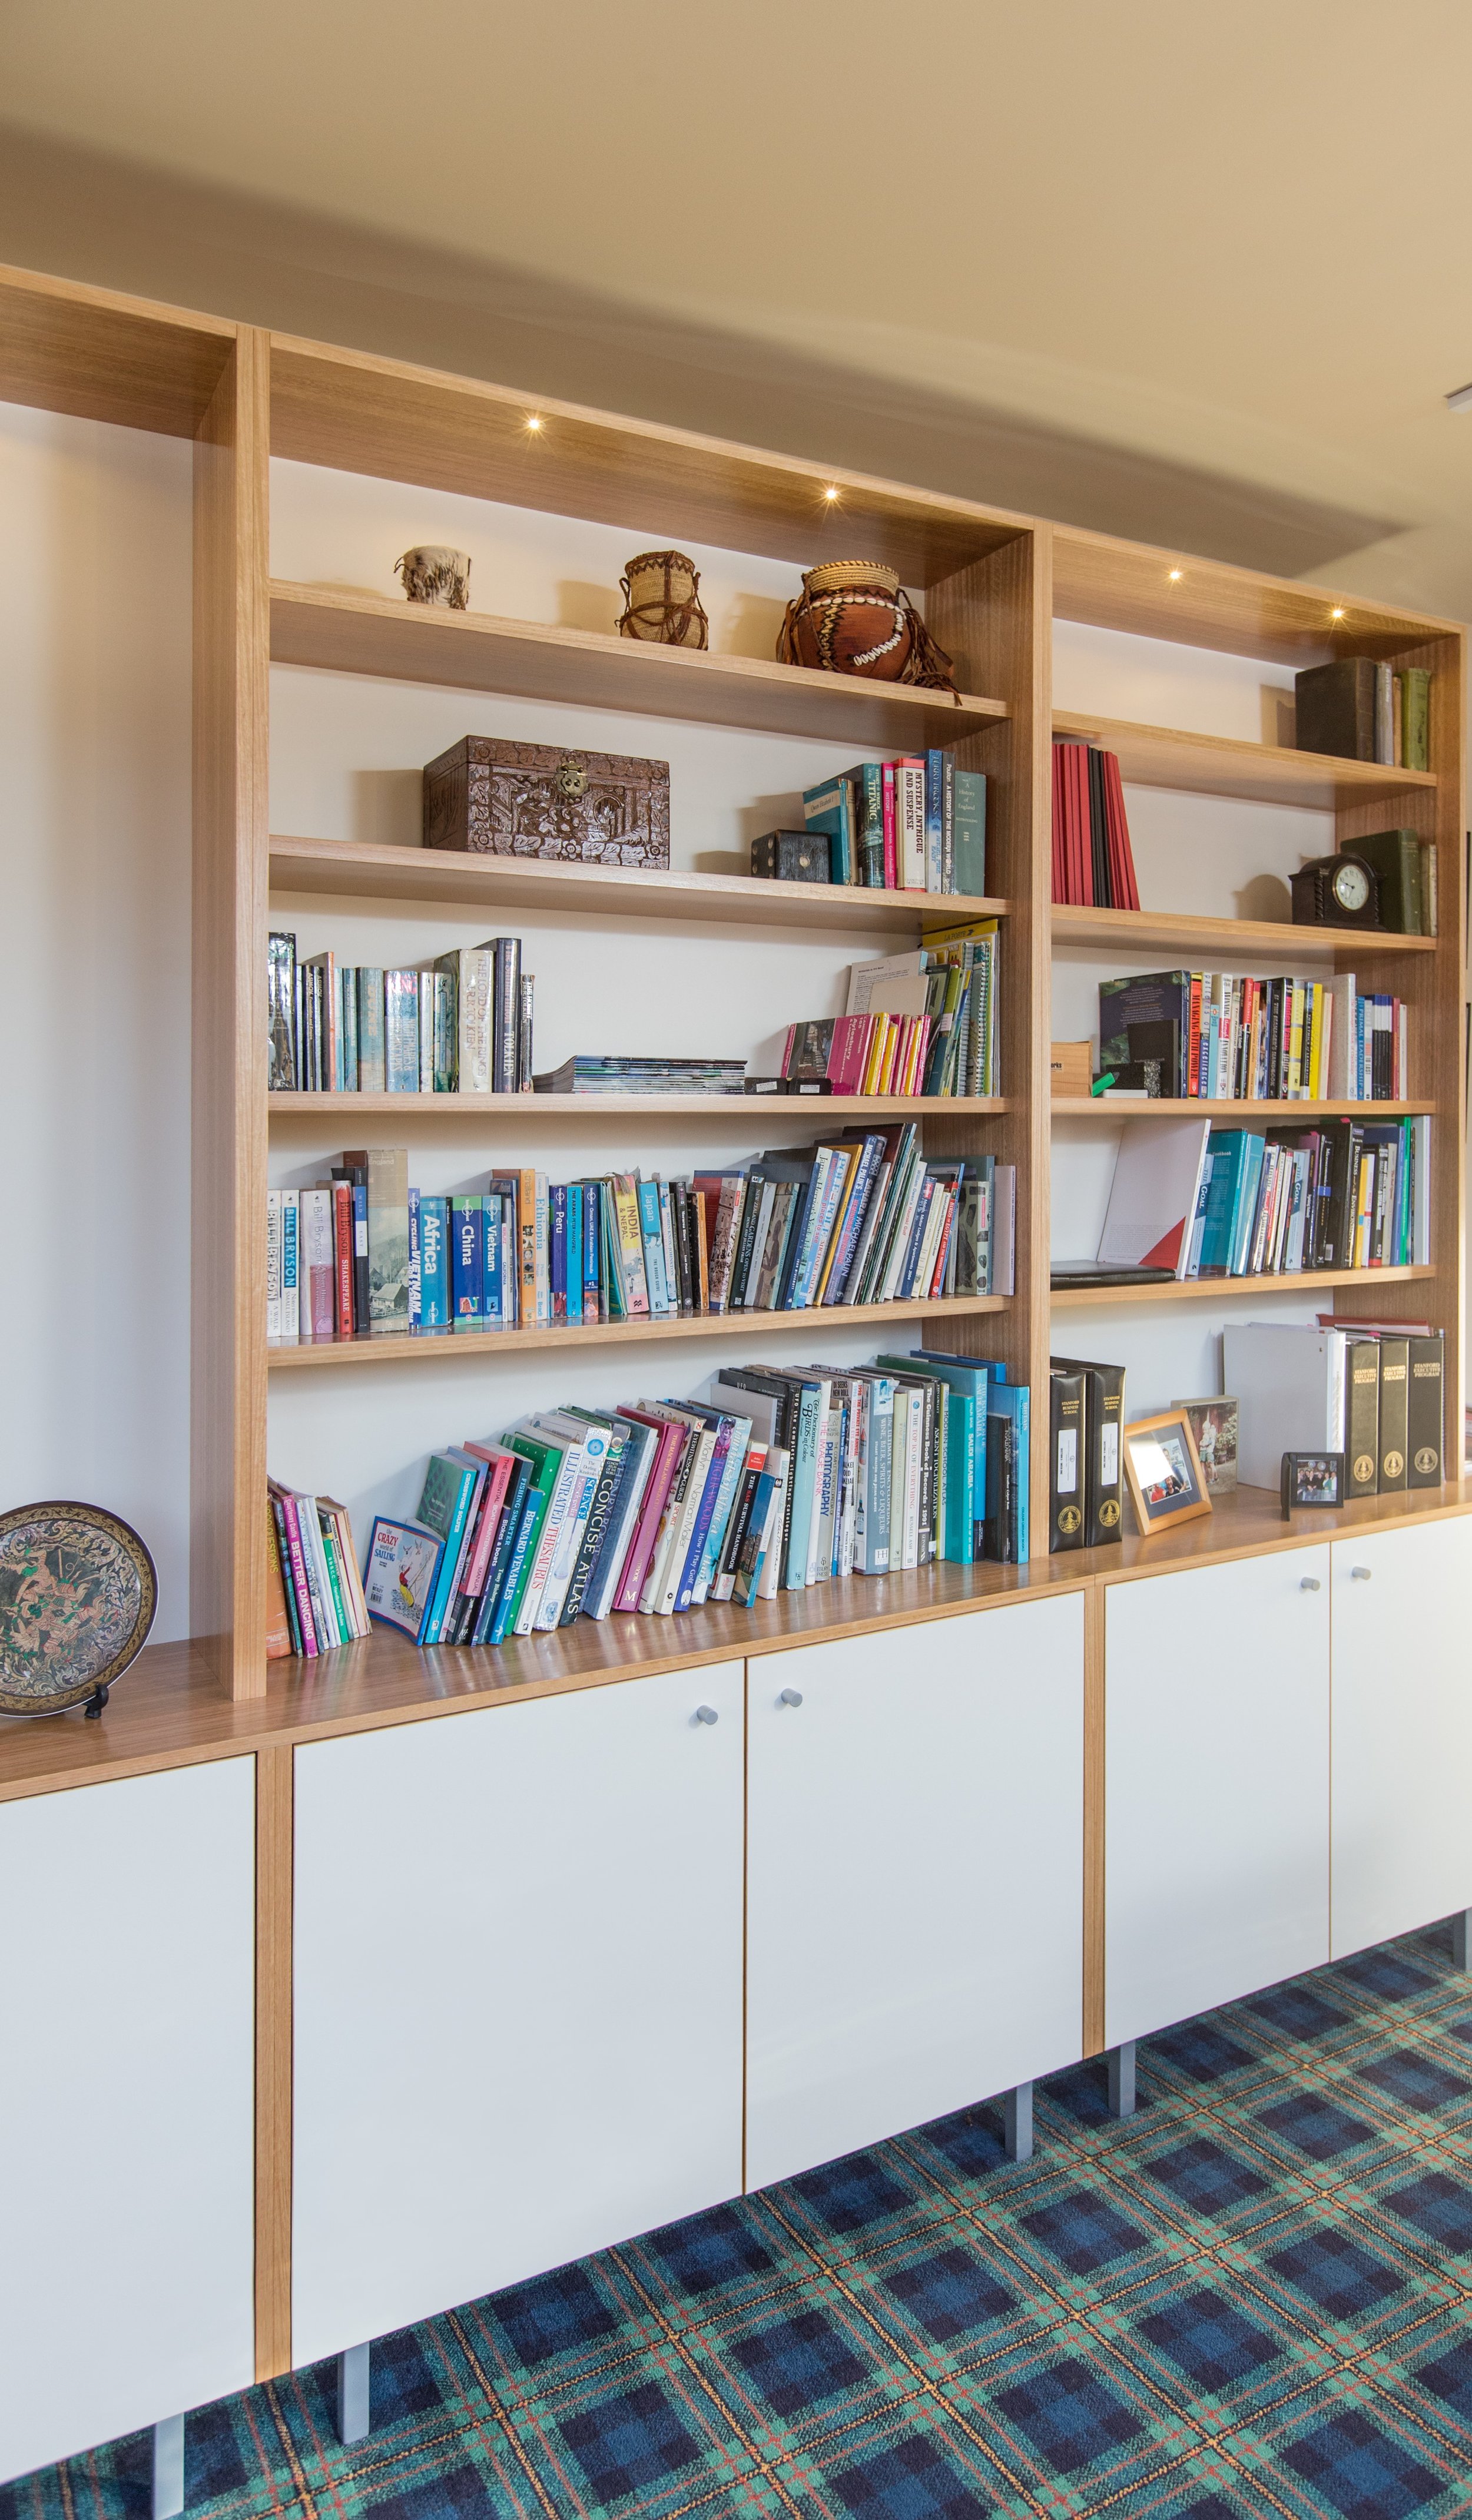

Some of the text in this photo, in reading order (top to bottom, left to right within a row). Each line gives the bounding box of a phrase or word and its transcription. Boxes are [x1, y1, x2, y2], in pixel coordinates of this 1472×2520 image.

[367, 985, 377, 1036] DUNE
[478, 957, 486, 1076] THE LORD OF THE RINGS
[1192, 994, 1200, 1029] MANAGING
[504, 1031, 514, 1076] TOLKIEN
[856, 1144, 873, 1190] MICHAEL PALIN'S
[645, 1194, 655, 1221] Japan
[904, 1207, 913, 1225] Hauraki
[1199, 1186, 1208, 1209] GOAL
[313, 1206, 324, 1262] Bill Bryson
[339, 1201, 350, 1254] Bill Bryson
[536, 1198, 545, 1249] Ethiopia
[627, 1206, 639, 1239] INDIA
[745, 1226, 755, 1257] GARDENS
[842, 1178, 873, 1277] SAHARA MICHAEL PALIN
[286, 1208, 295, 1285] BILL BRYSON
[425, 1215, 440, 1274] Africa
[462, 1225, 473, 1265] China
[488, 1225, 497, 1271] Vietnam
[910, 1246, 918, 1269] Apartments
[412, 1251, 420, 1314] VIETNAM
[677, 1434, 699, 1501] EYEWITNESS GUIDES
[817, 1439, 826, 1469] IMAGE
[911, 1454, 917, 1464] OF
[923, 1460, 930, 1470] of
[495, 1472, 507, 1503] ESSENTIAL
[578, 1478, 596, 1518] SCIENCE
[679, 1440, 714, 1549] Marilyn Norman Mailer
[821, 1442, 833, 1516] PHOTOGRAPHY
[284, 1499, 295, 1523] Courtenay
[454, 1473, 471, 1533] CROSSWORD SOLVER
[490, 1505, 498, 1521] BOAT
[505, 1478, 527, 1546] FISHING SMARTER
[532, 1451, 580, 1589] ILLUSTRATED THESAURUS
[671, 1504, 679, 1526] SPORT
[736, 1503, 750, 1533] SURVIVAL
[378, 1532, 398, 1546] CRAZY
[479, 1523, 494, 1565] MAINTENANCE
[498, 1520, 509, 1541] Blokes
[567, 1479, 612, 1614] CONCISE ATLAS
[374, 1549, 395, 1561] SAILING
[492, 1547, 502, 1567] boats
[504, 1510, 536, 1600] BERNARD VENABLES
[728, 1534, 741, 1569] HANDBOOK
[291, 1541, 313, 1639] BETTER DANCING
[473, 1567, 482, 1593] MANUAL
